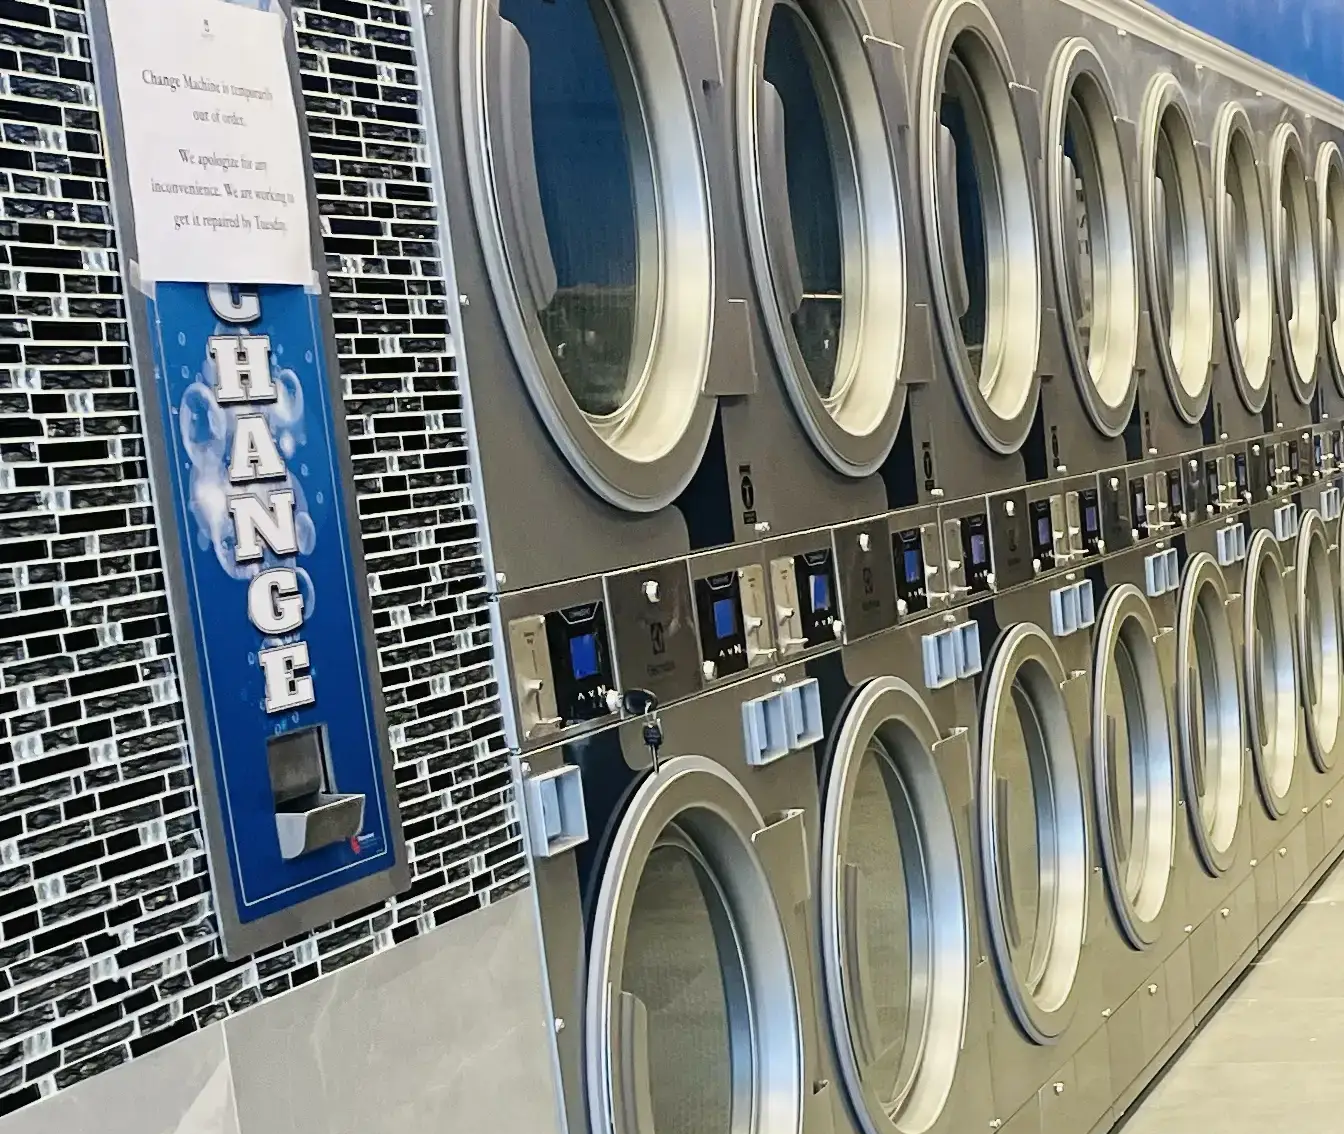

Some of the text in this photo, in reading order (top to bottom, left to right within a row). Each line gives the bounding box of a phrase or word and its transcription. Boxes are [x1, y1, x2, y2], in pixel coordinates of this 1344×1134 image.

[142, 69, 180, 92] Change
[182, 73, 220, 94] Machine
[192, 110, 209, 122] out
[211, 108, 221, 123] of
[179, 148, 195, 164] We
[223, 183, 238, 198] We
[173, 214, 189, 230] get
[192, 211, 201, 226] it
[202, 213, 240, 231] repaired
[207, 283, 317, 715] CHANGE
